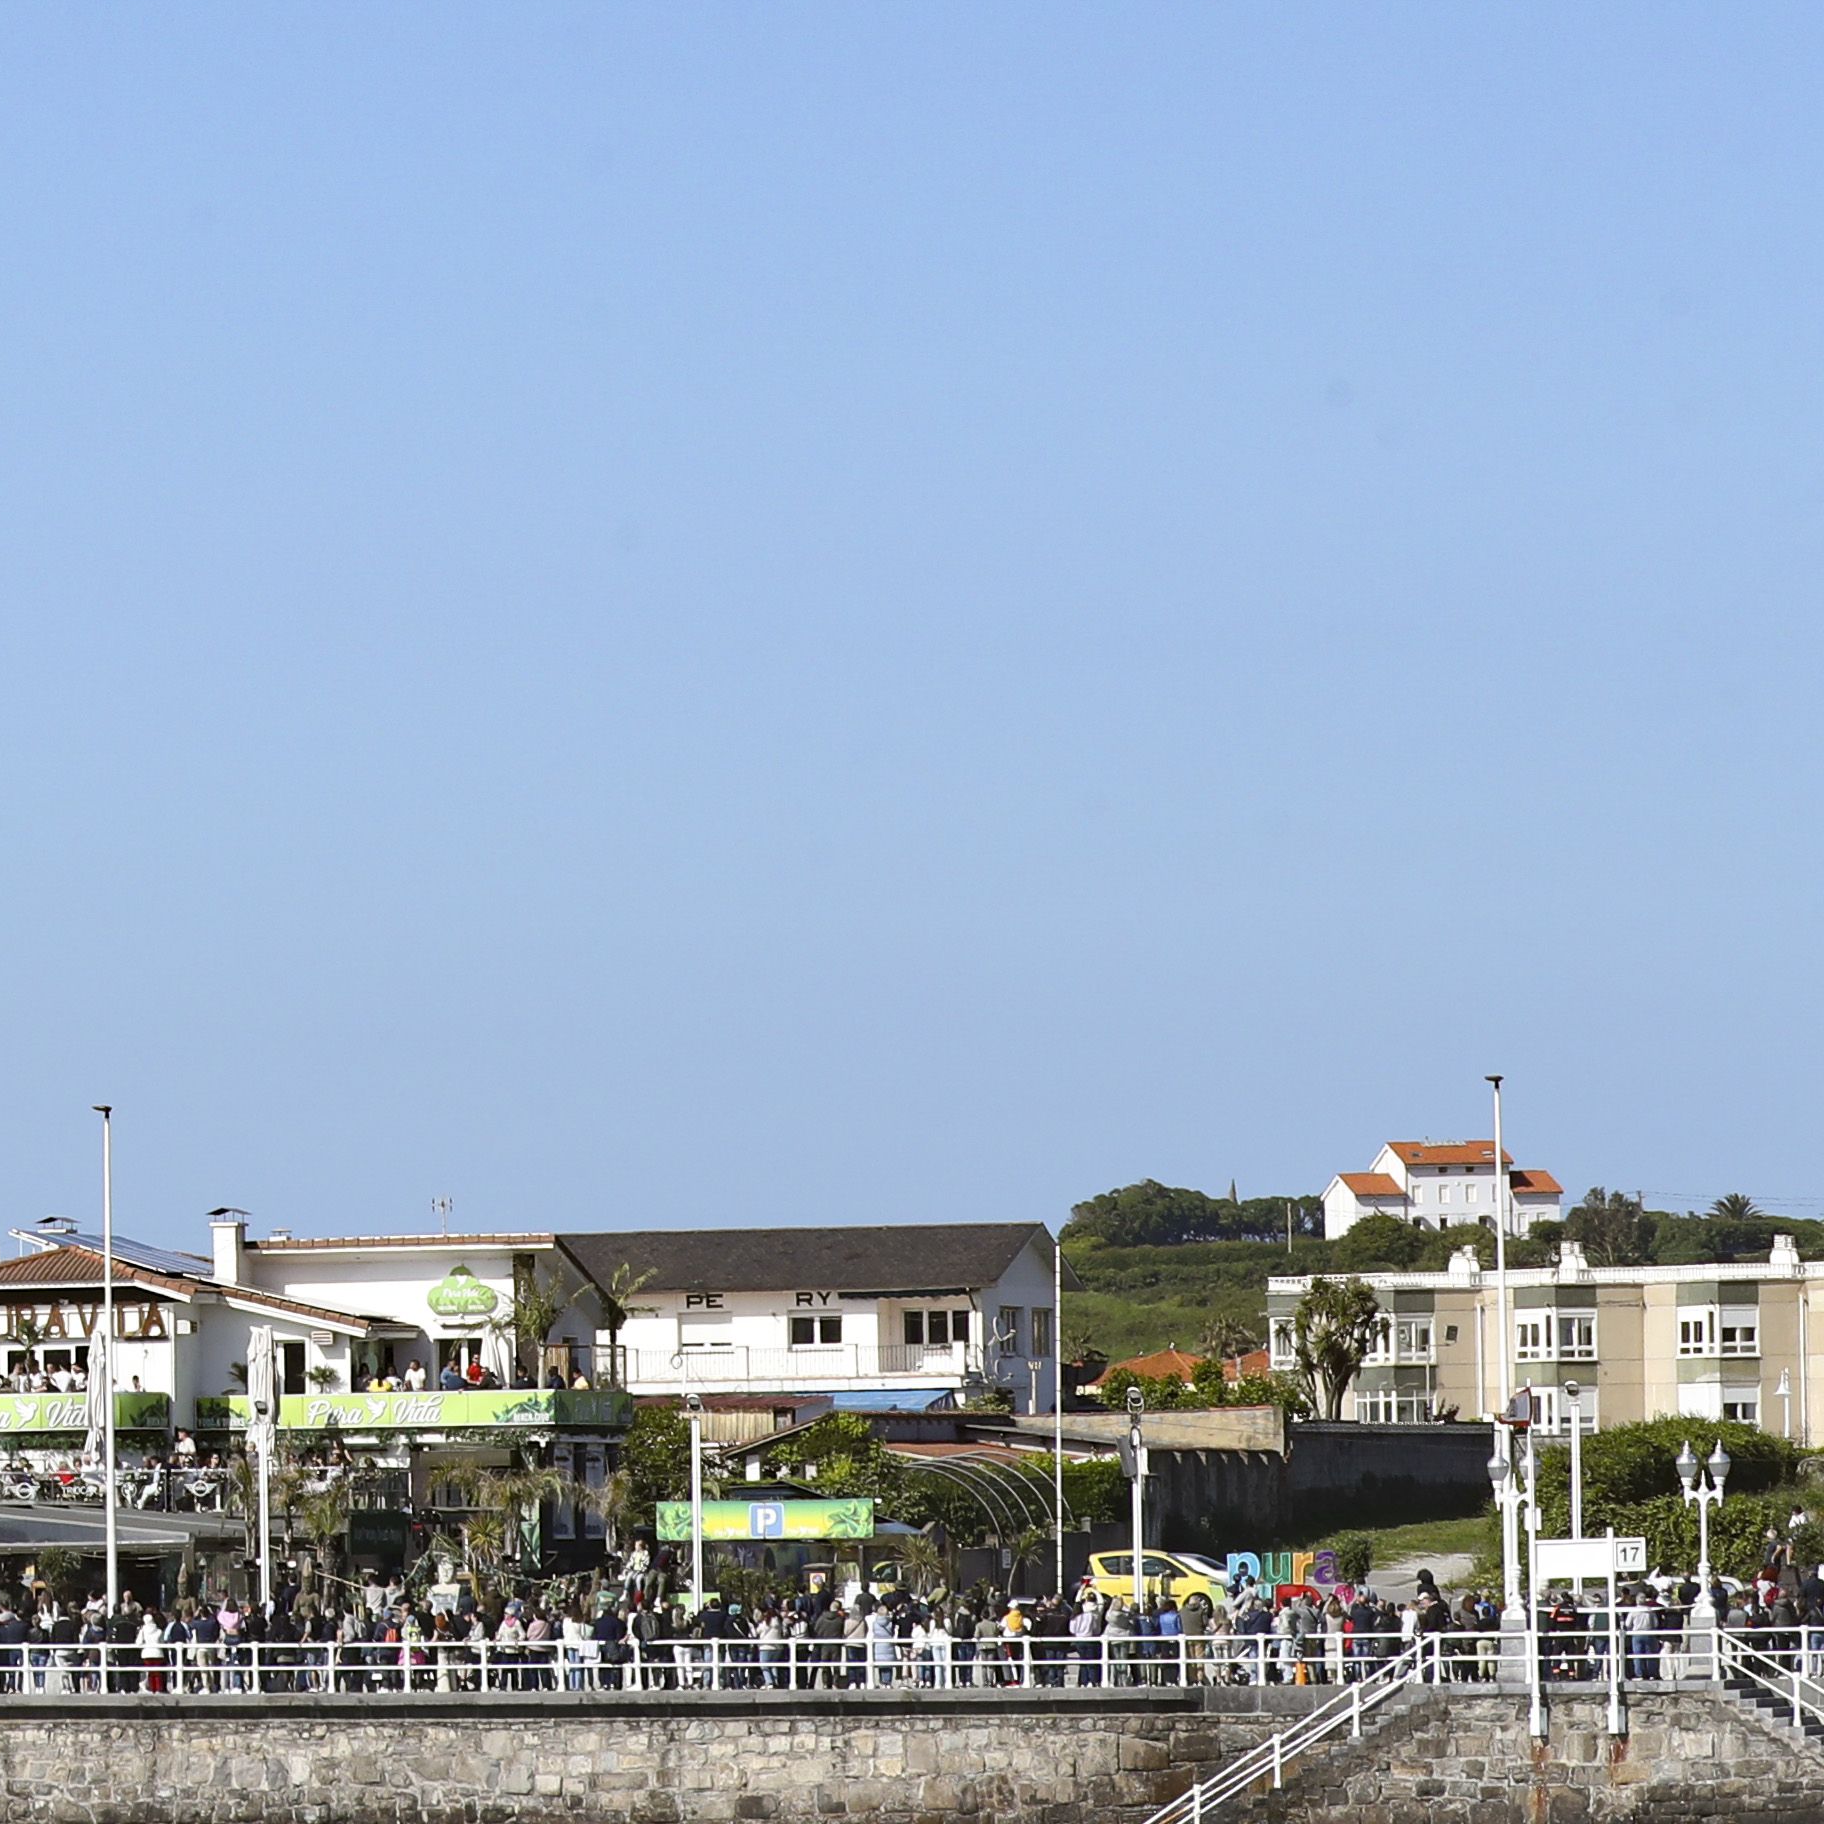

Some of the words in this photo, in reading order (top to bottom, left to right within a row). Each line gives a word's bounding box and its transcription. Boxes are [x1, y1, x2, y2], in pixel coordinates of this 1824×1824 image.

[77, 1301, 167, 1340] VDA
[46, 1397, 90, 1428] Vid
[308, 1400, 363, 1425] Pura
[393, 1394, 444, 1424] Vida
[756, 1508, 777, 1534] P
[1226, 1549, 1338, 1586] pura
[1619, 1546, 1640, 1563] 17
